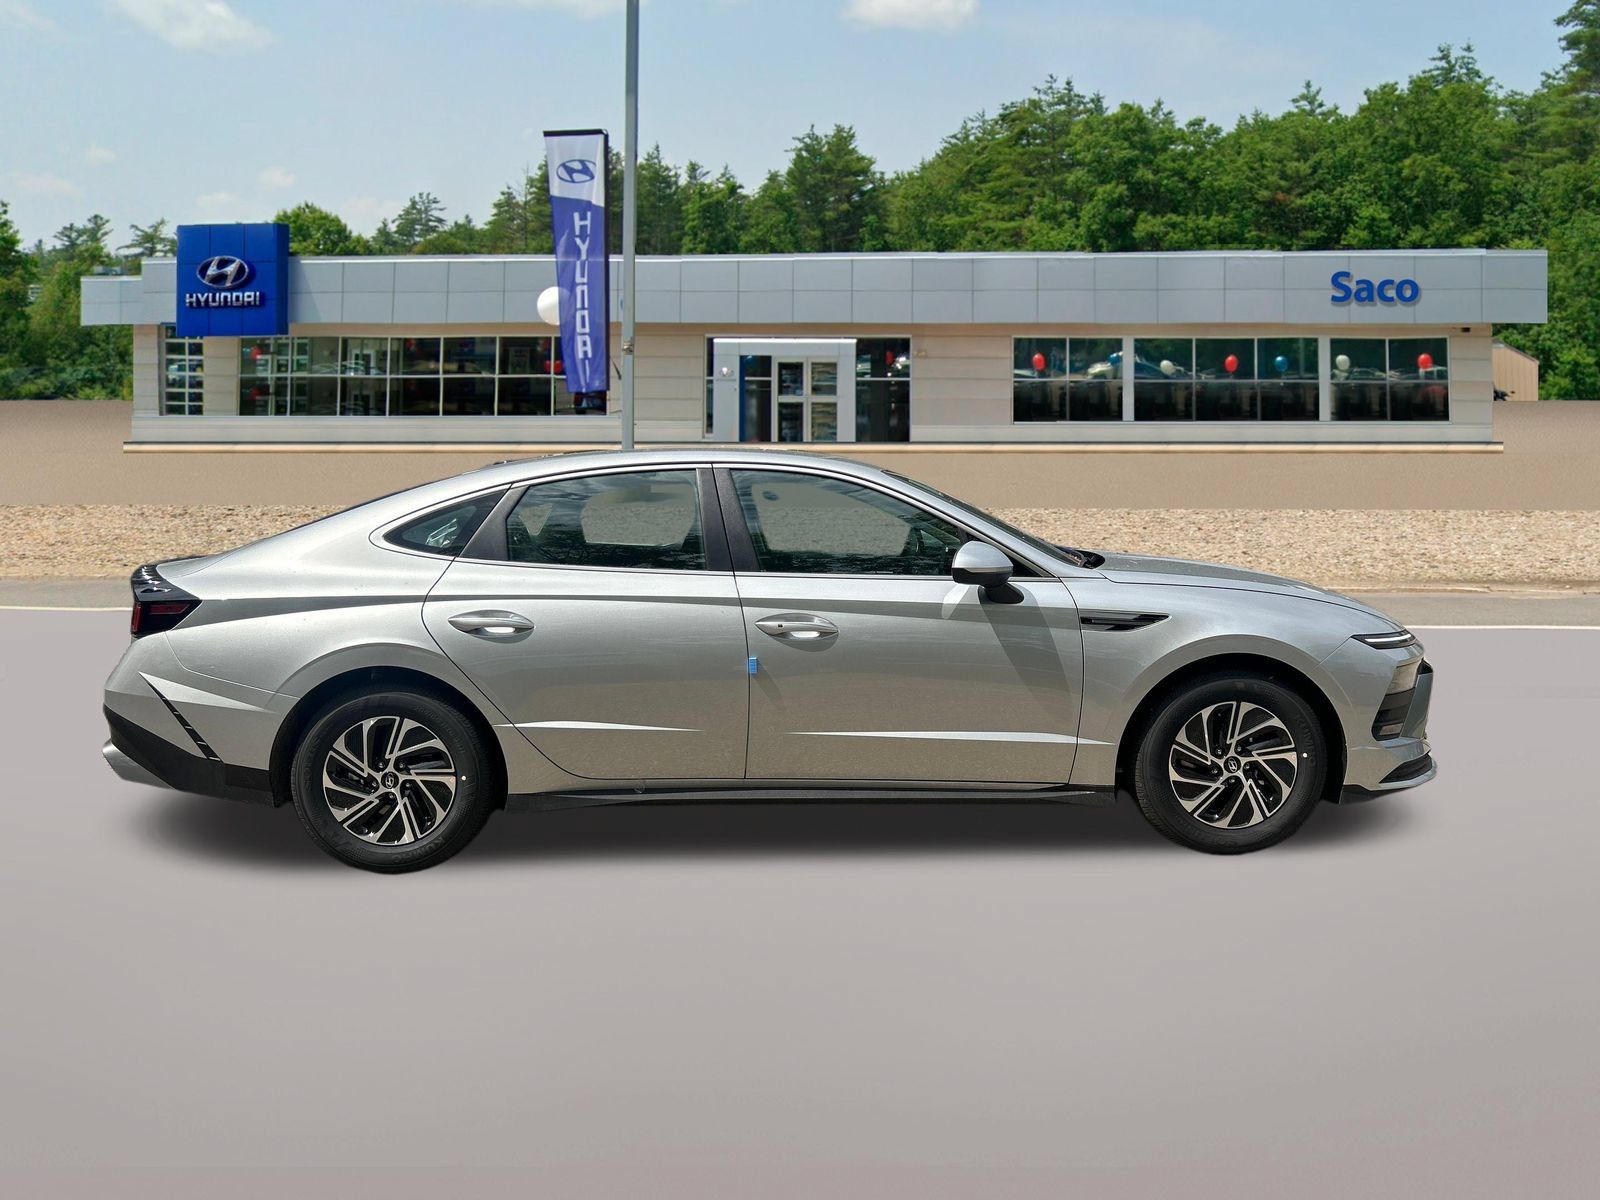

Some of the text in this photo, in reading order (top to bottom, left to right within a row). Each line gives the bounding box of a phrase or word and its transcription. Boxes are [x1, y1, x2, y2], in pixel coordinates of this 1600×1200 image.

[185, 291, 260, 307] HYUNDAI
[573, 211, 593, 383] HYUNDAI
[1330, 270, 1420, 304] Saco
